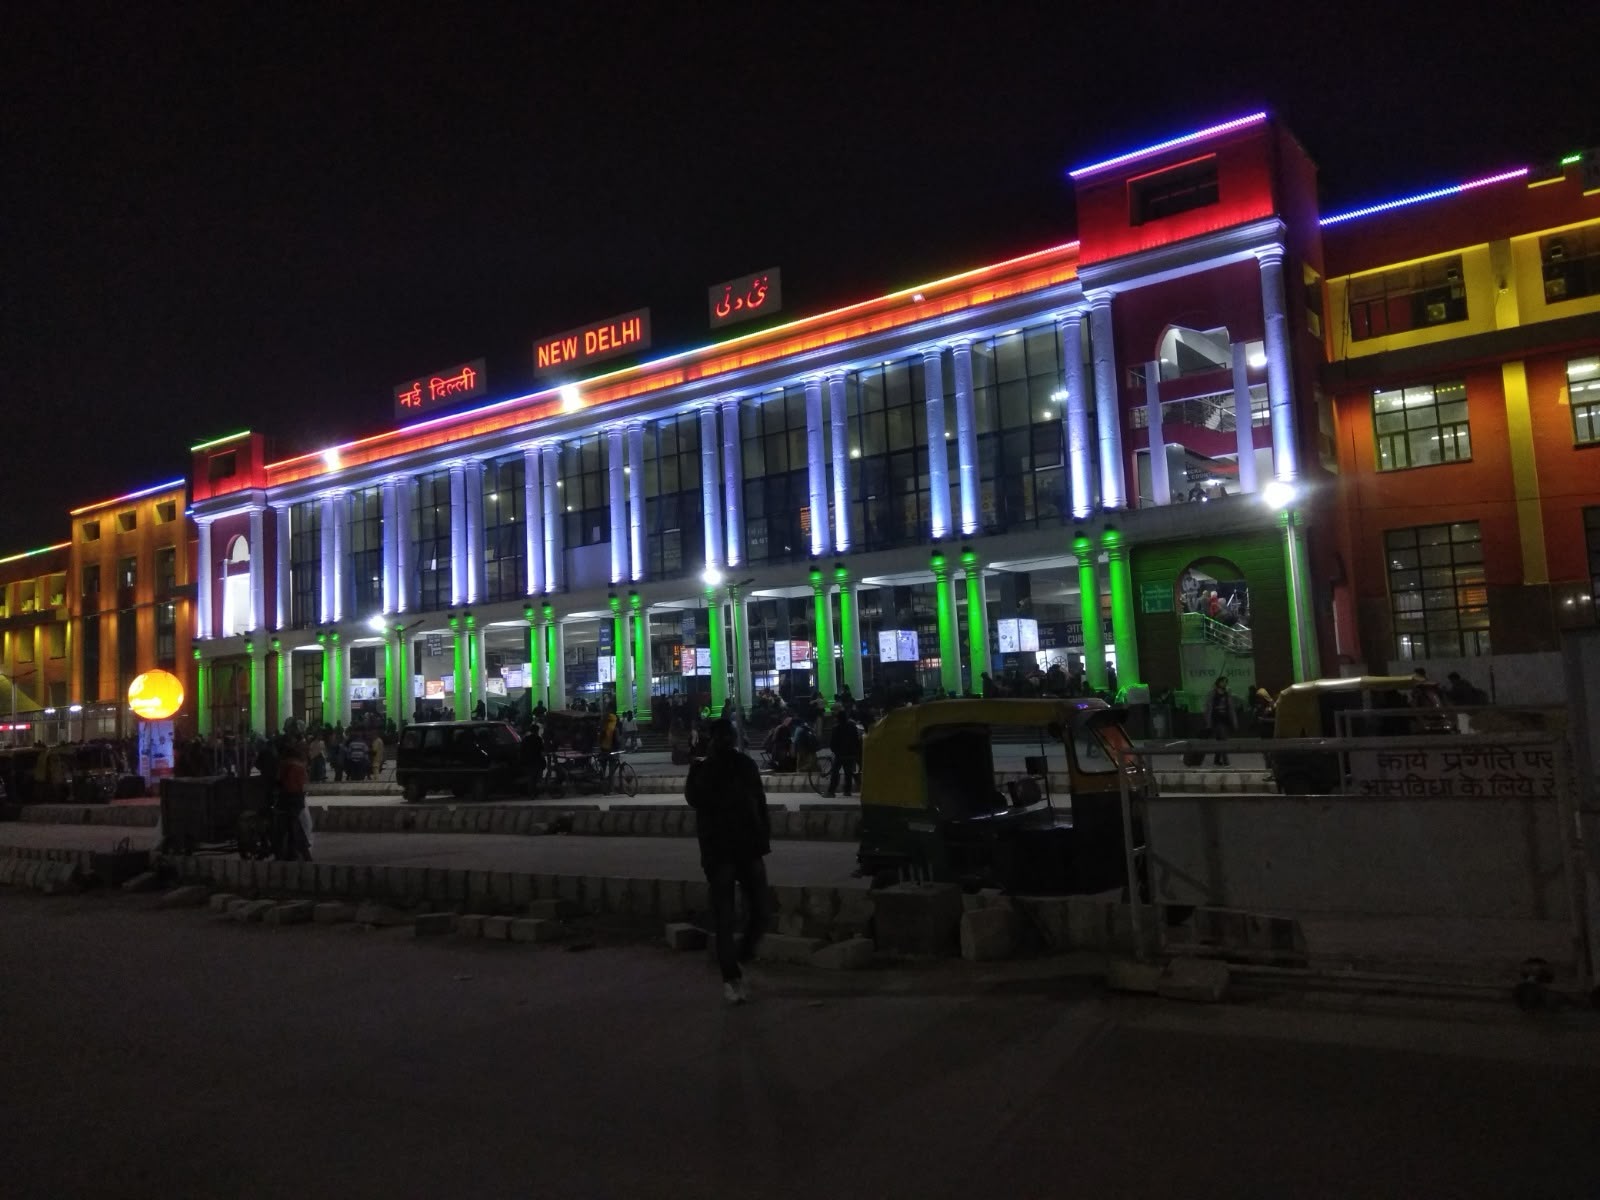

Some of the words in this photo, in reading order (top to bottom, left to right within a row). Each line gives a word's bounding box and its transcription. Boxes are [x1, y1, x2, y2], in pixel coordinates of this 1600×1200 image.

[538, 336, 578, 368] NEW
[585, 317, 641, 355] DELHI
[399, 382, 422, 408] नई
[428, 367, 476, 401] दिल्ली
